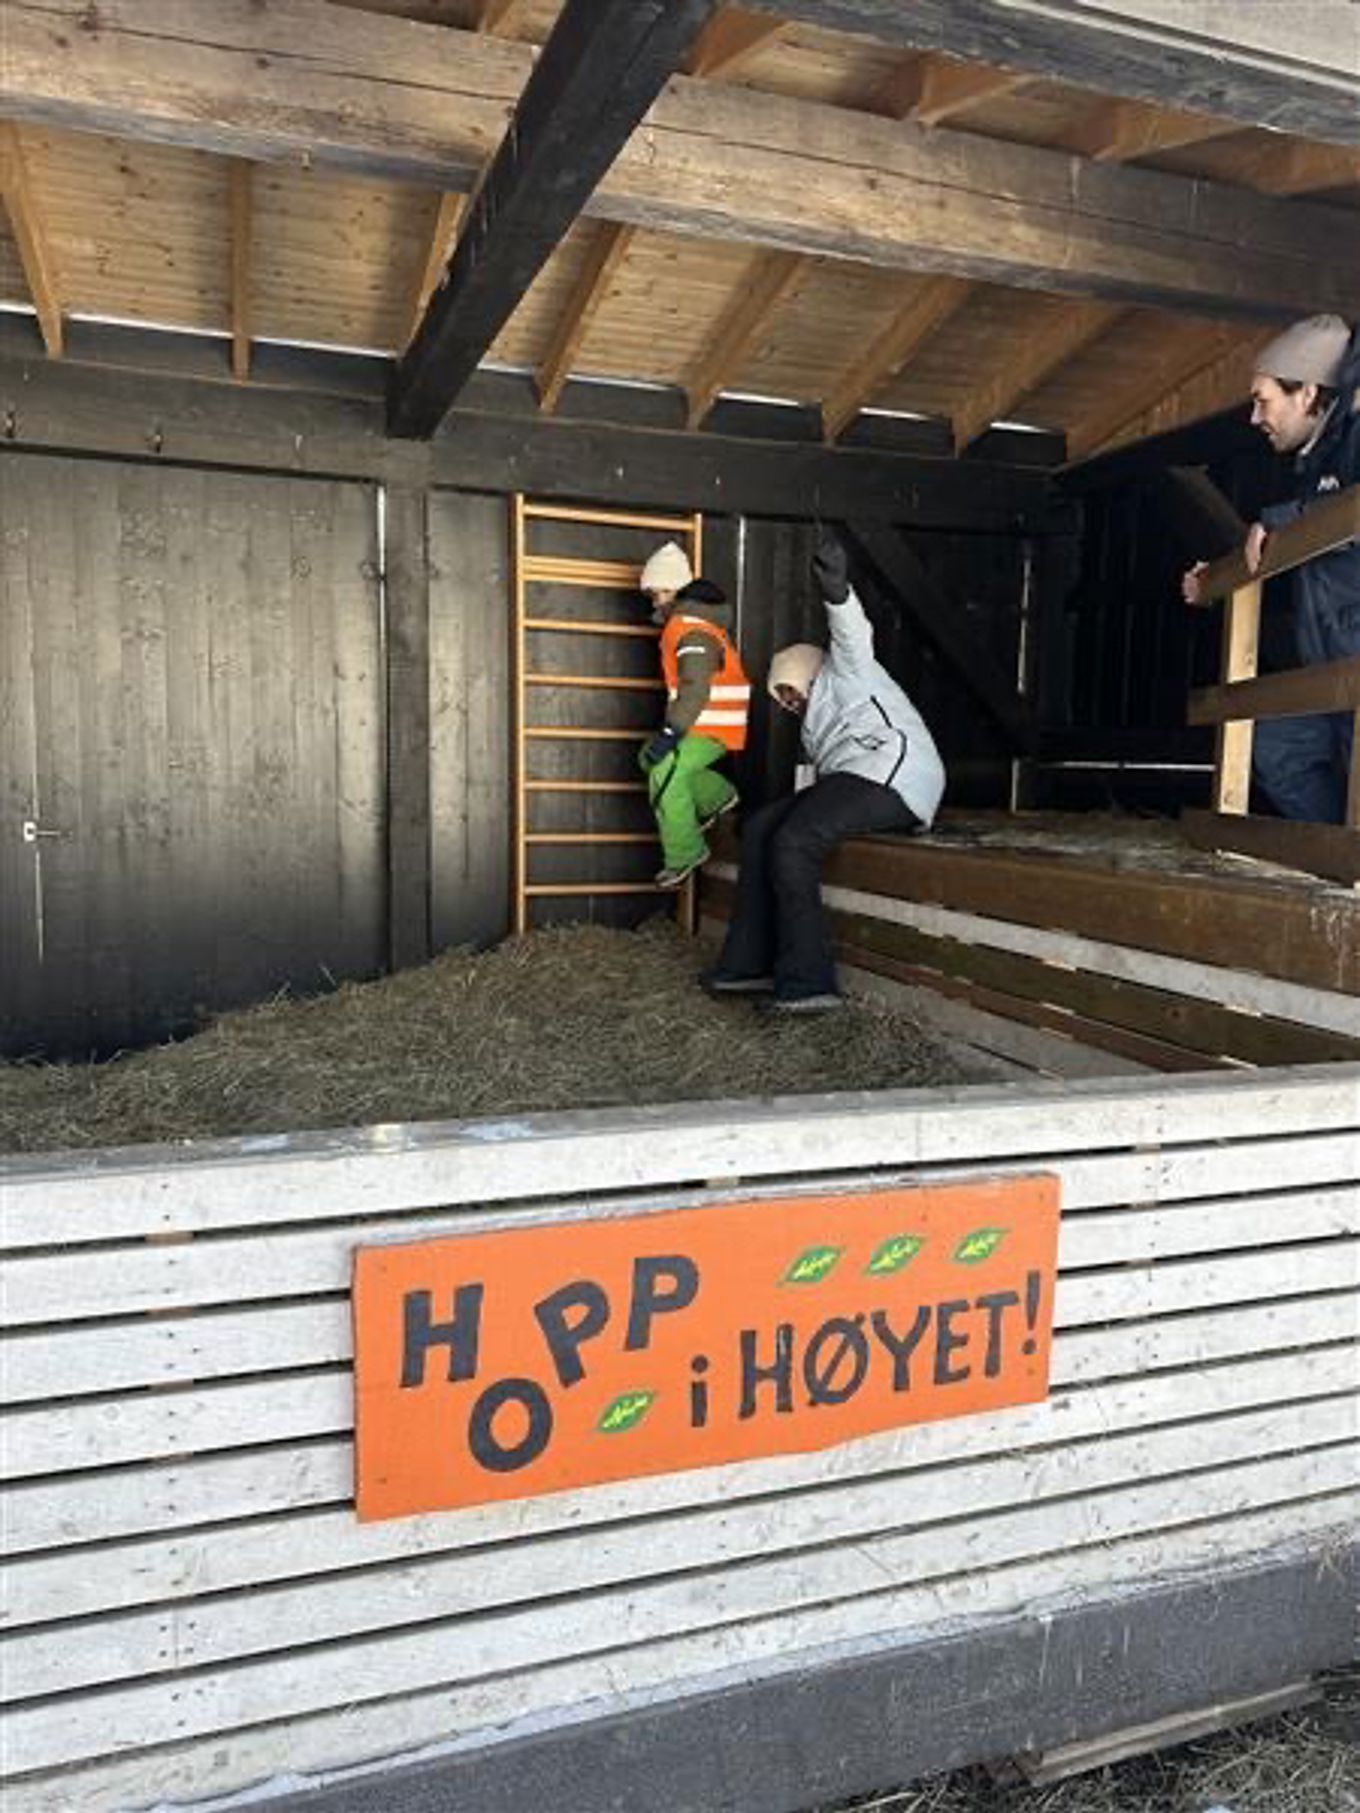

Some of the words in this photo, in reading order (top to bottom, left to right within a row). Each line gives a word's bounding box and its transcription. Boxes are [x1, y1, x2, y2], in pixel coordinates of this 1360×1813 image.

[400, 1255, 700, 1473] HOPP
[690, 1355, 709, 1428] i
[738, 1271, 1041, 1420] HØYET!
